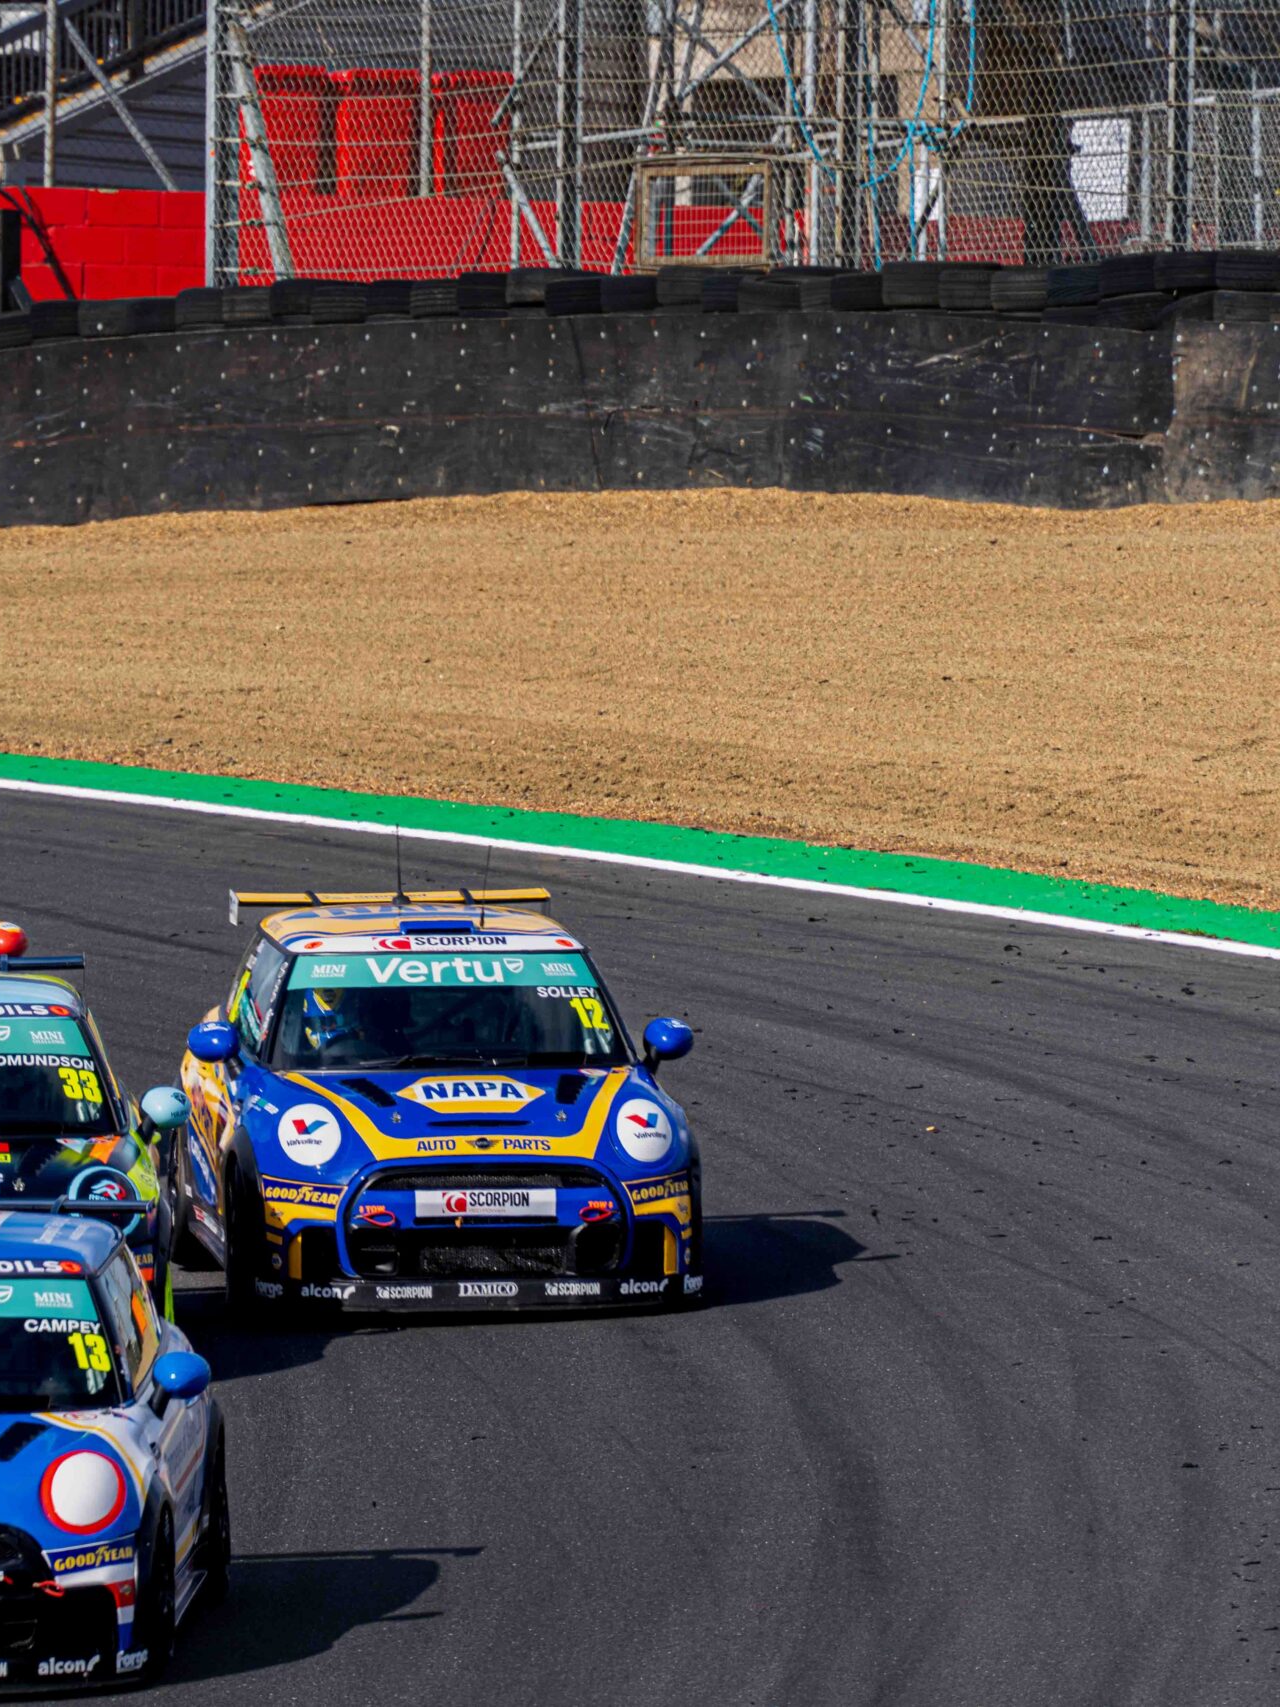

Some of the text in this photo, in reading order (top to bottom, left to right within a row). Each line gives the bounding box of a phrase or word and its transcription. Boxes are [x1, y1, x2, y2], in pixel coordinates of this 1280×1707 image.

[414, 935, 508, 948] SCORPION
[311, 964, 348, 973] MINI
[365, 957, 505, 984] Vertu
[540, 962, 575, 972] MINI
[536, 986, 596, 999] SOLLEY
[569, 997, 609, 1030] 12
[30, 1031, 63, 1041] MINI
[58, 1067, 103, 1104] 33
[421, 1081, 524, 1100] NAPA
[286, 1137, 323, 1147] Valvoline
[633, 1131, 667, 1141] Valvoline
[417, 1138, 551, 1152] AUTO PARTS
[265, 1186, 339, 1206] GOODYEAR
[631, 1180, 689, 1201] GOODYEAR
[468, 1191, 529, 1208] SCORPION
[588, 1200, 608, 1208] TOW
[365, 1204, 386, 1213] TOW
[300, 1284, 342, 1299] alcon
[390, 1286, 432, 1299] SCORPION
[458, 1282, 518, 1297] DAMICO
[559, 1283, 600, 1296] SCORPION
[620, 1279, 658, 1294] alcon
[34, 1292, 72, 1302] MINI
[23, 1319, 101, 1334] CAMPEY
[68, 1332, 112, 1373] 13
[54, 1545, 133, 1572] GOODYEAR
[38, 1656, 86, 1676] alcon
[116, 1649, 148, 1673] forge
